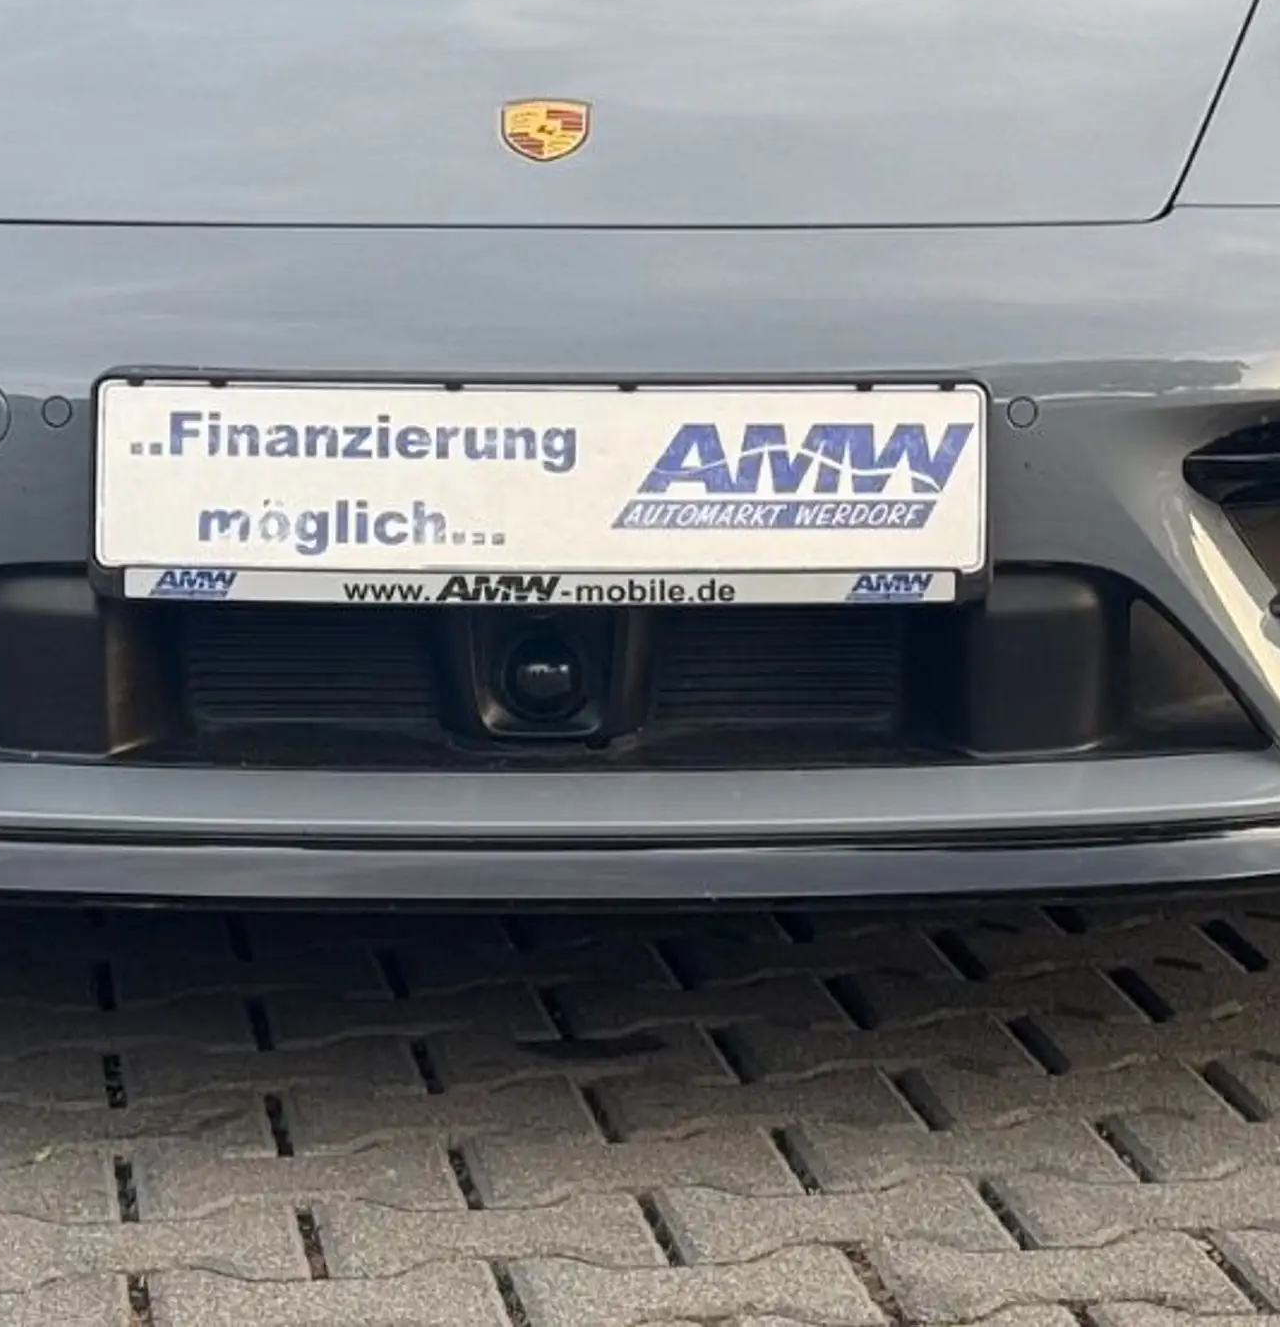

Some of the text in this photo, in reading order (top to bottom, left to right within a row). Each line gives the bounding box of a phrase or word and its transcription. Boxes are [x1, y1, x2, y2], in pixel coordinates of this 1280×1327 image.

[636, 422, 975, 494] AMW
[622, 501, 926, 526] AUTOMARKT WERDORF
[156, 570, 238, 589] AMW
[344, 575, 737, 603] www.AMW-mobile.de
[851, 573, 934, 592] AMW
